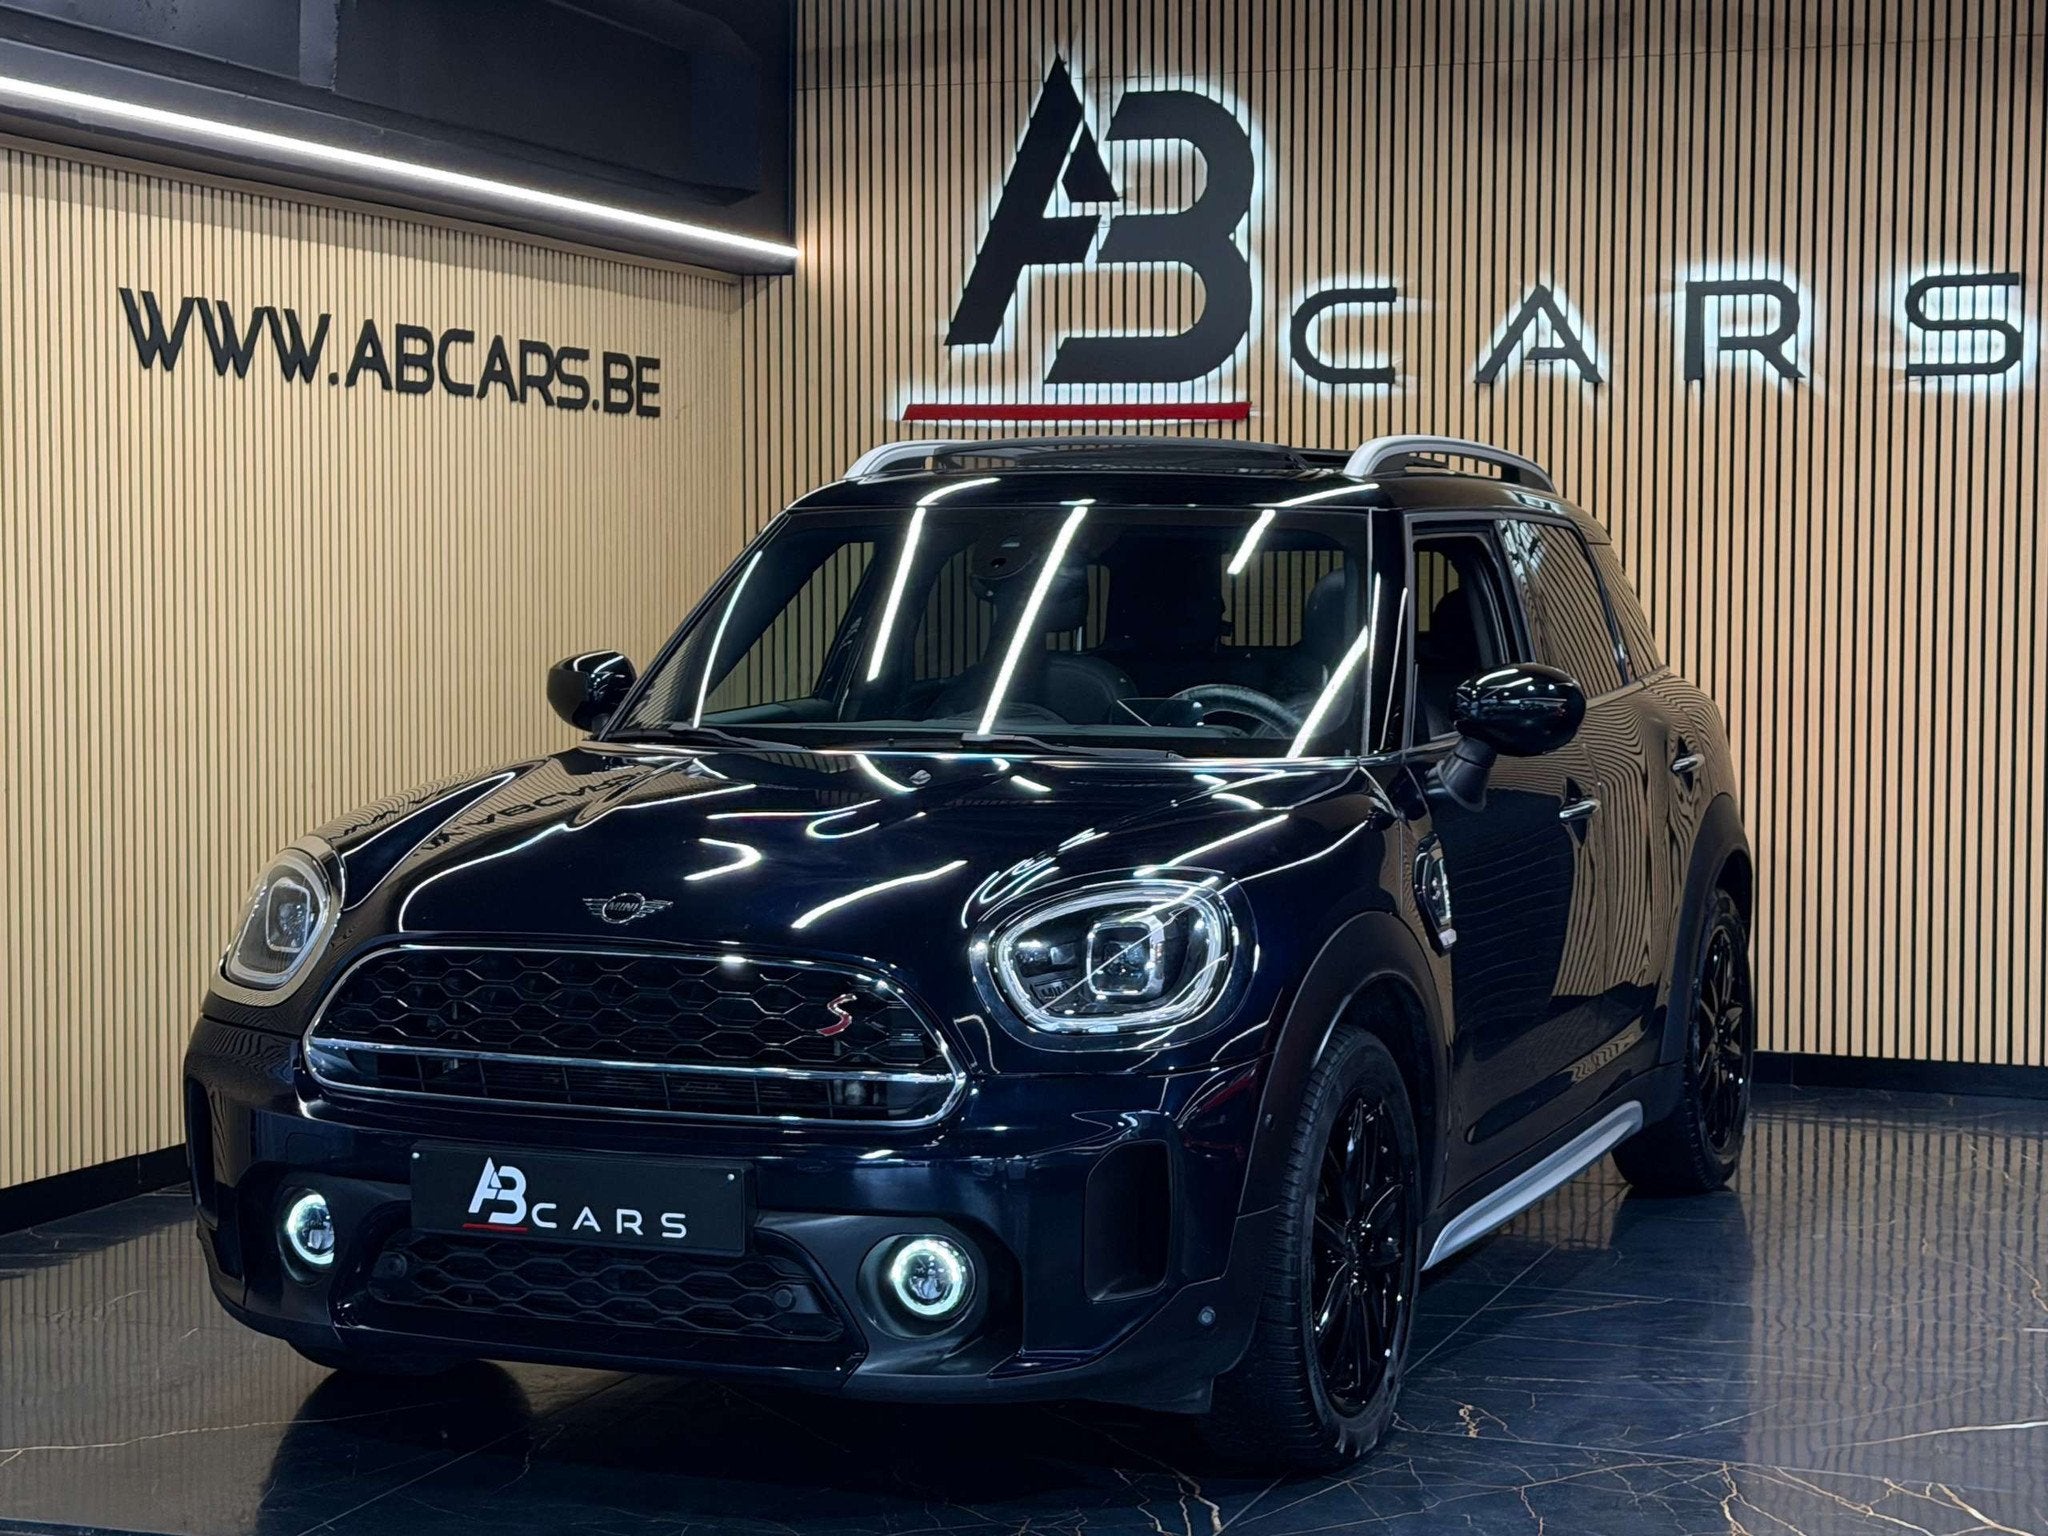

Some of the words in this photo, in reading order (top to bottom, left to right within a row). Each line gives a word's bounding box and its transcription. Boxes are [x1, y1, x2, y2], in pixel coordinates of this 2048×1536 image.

[944, 54, 1254, 384] AB
[1290, 272, 2024, 384] CARS
[118, 287, 661, 417] WWW.ABCARS.BE
[608, 902, 639, 911] MINI
[816, 994, 857, 1036] S
[468, 1157, 527, 1224] AB
[531, 1203, 687, 1239] CARS
